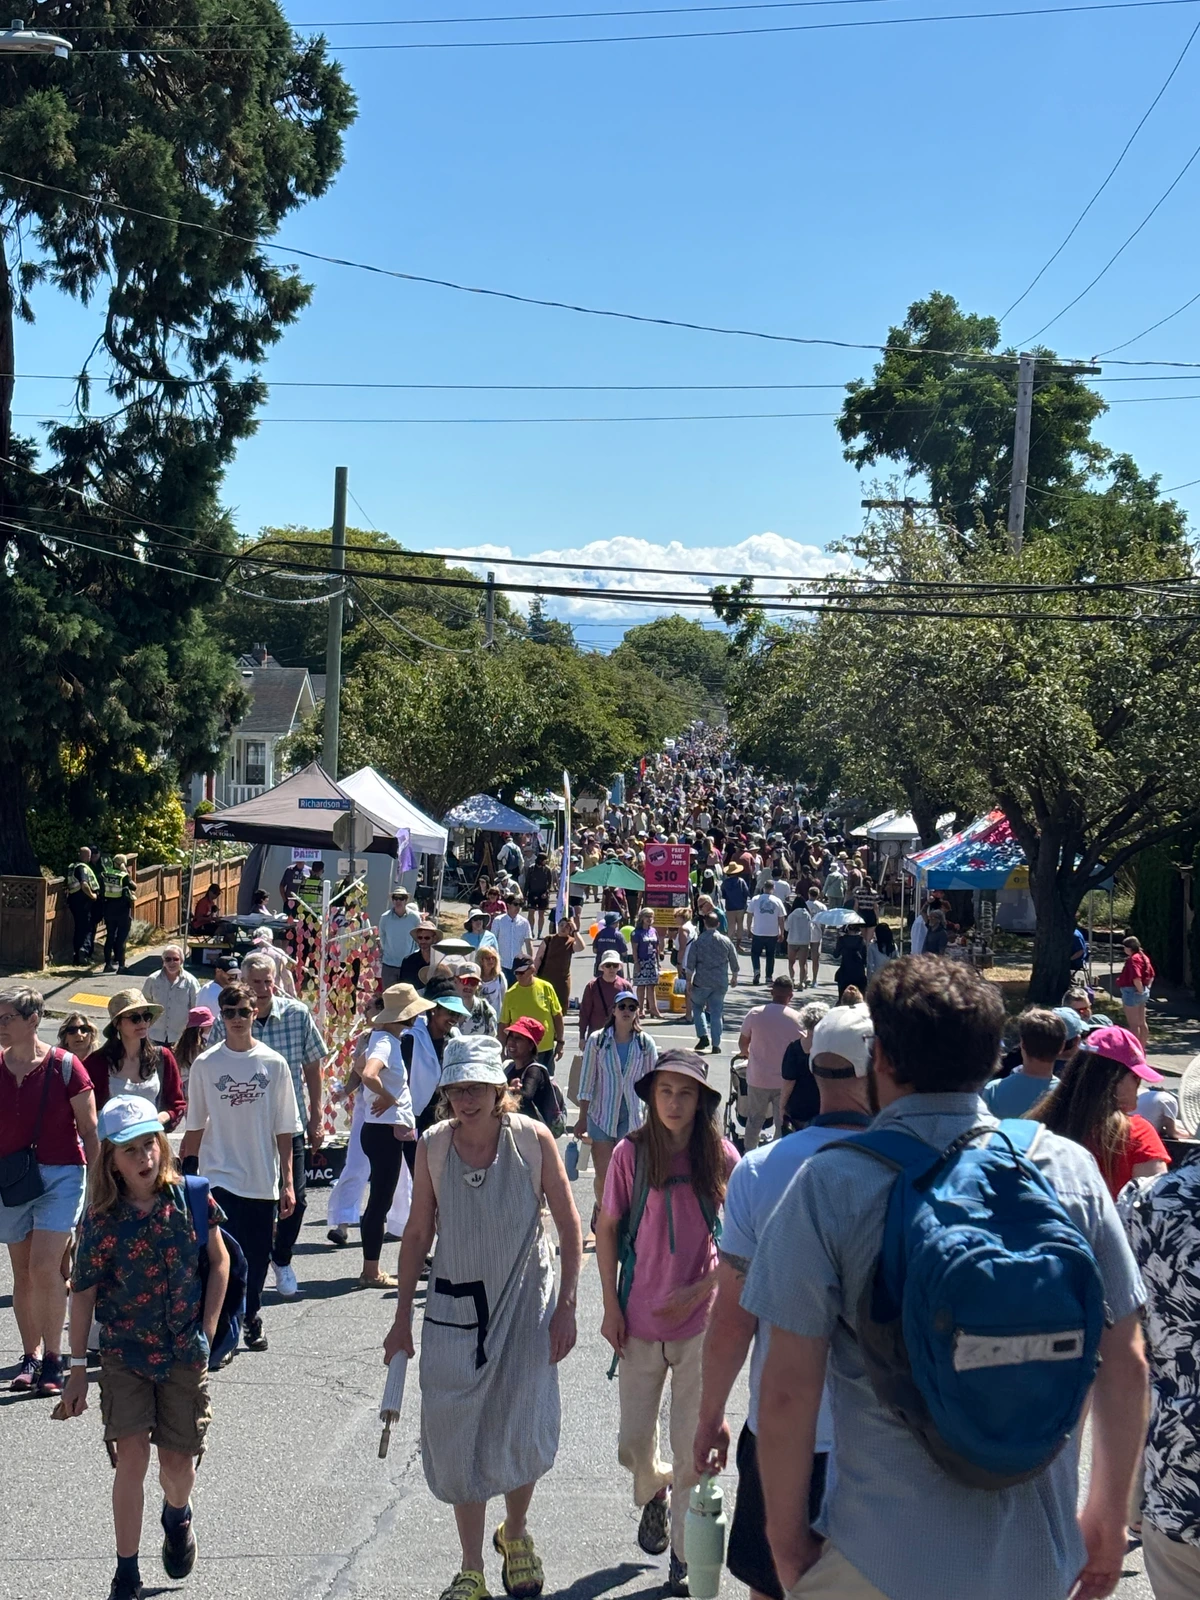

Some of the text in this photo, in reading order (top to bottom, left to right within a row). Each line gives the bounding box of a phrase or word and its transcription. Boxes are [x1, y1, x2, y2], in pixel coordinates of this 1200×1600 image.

[300, 799, 341, 808] Richardson
[654, 871, 677, 881] $10
[220, 1092, 265, 1100] CHEVROLET
[305, 1168, 333, 1180] MAC
